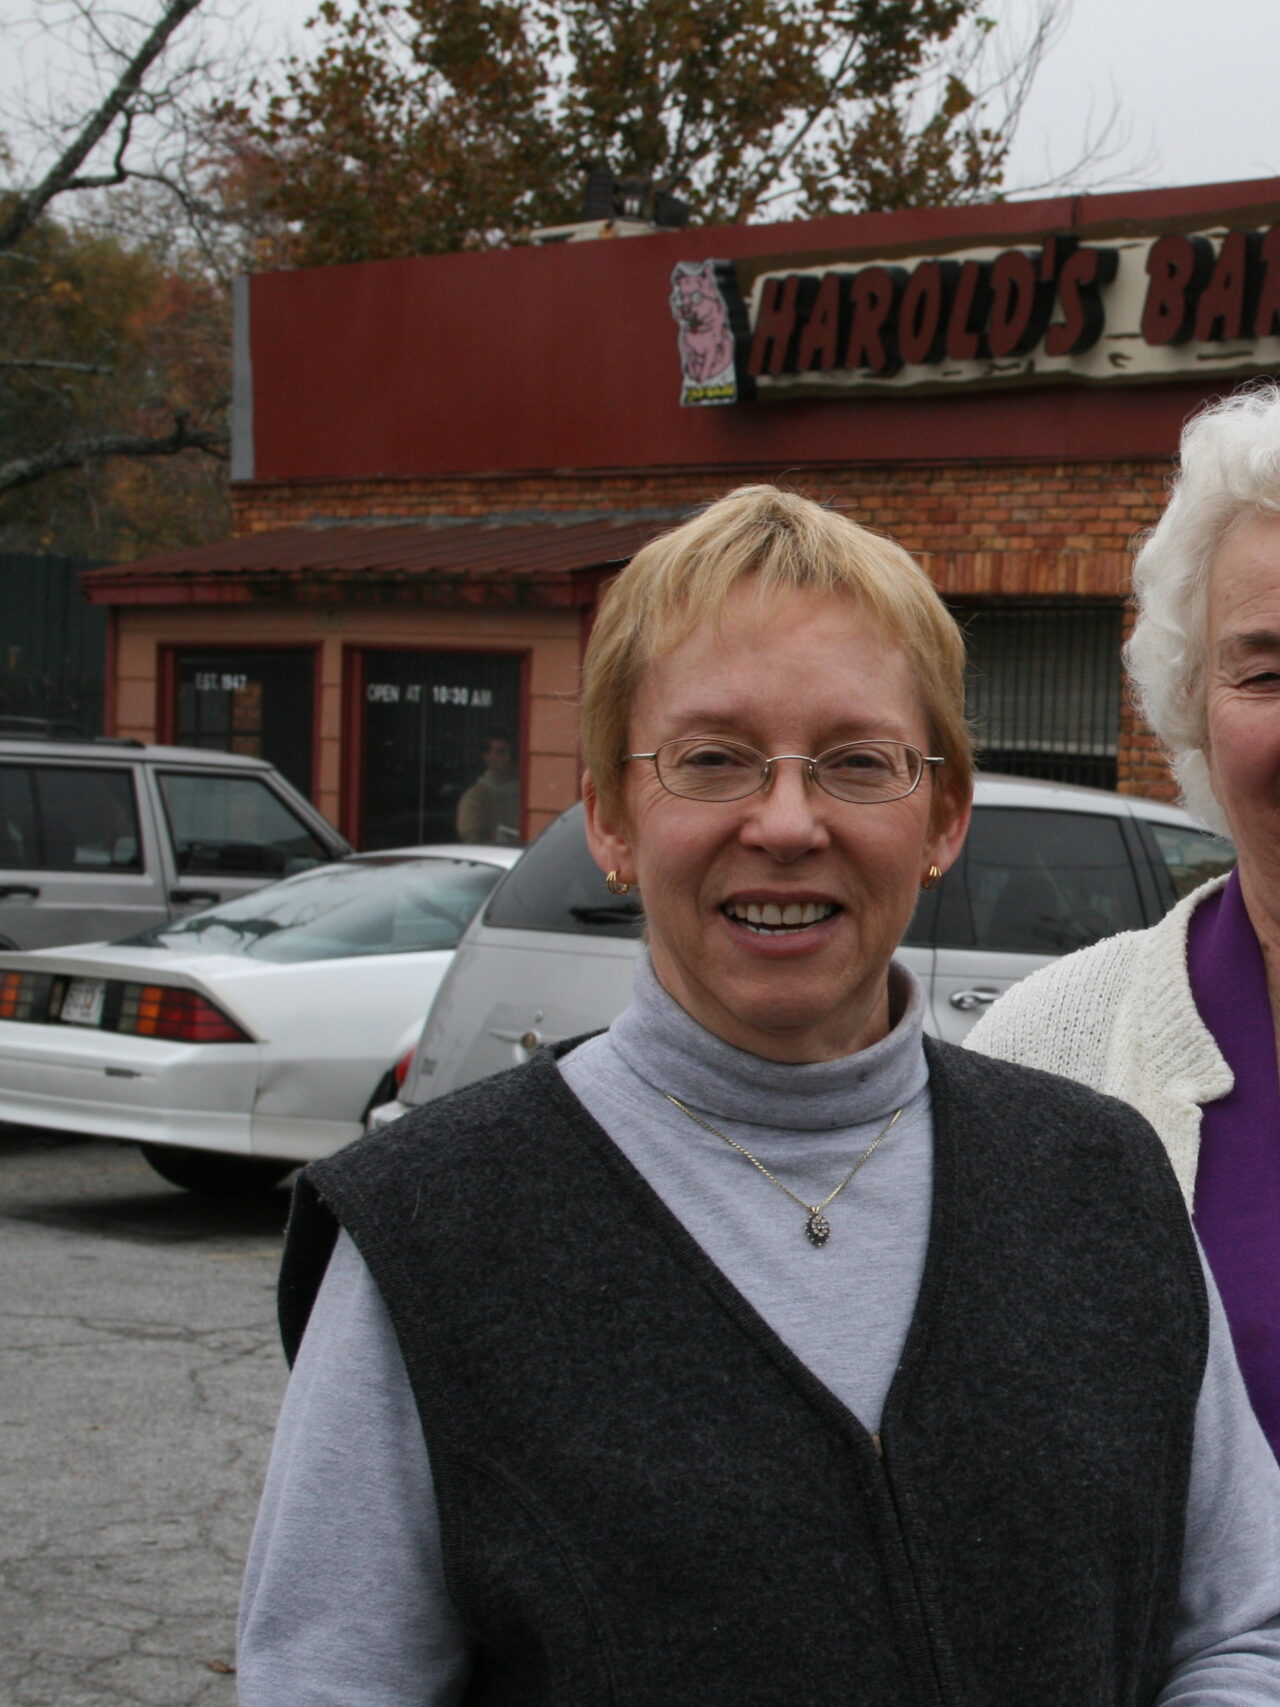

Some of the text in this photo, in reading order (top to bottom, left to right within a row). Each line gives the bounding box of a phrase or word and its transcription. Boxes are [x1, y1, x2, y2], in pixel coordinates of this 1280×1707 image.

[747, 235, 1104, 376] HAROLD'S
[366, 684, 399, 702] OPEN
[405, 684, 420, 701] AT
[433, 685, 469, 704] 10:30
